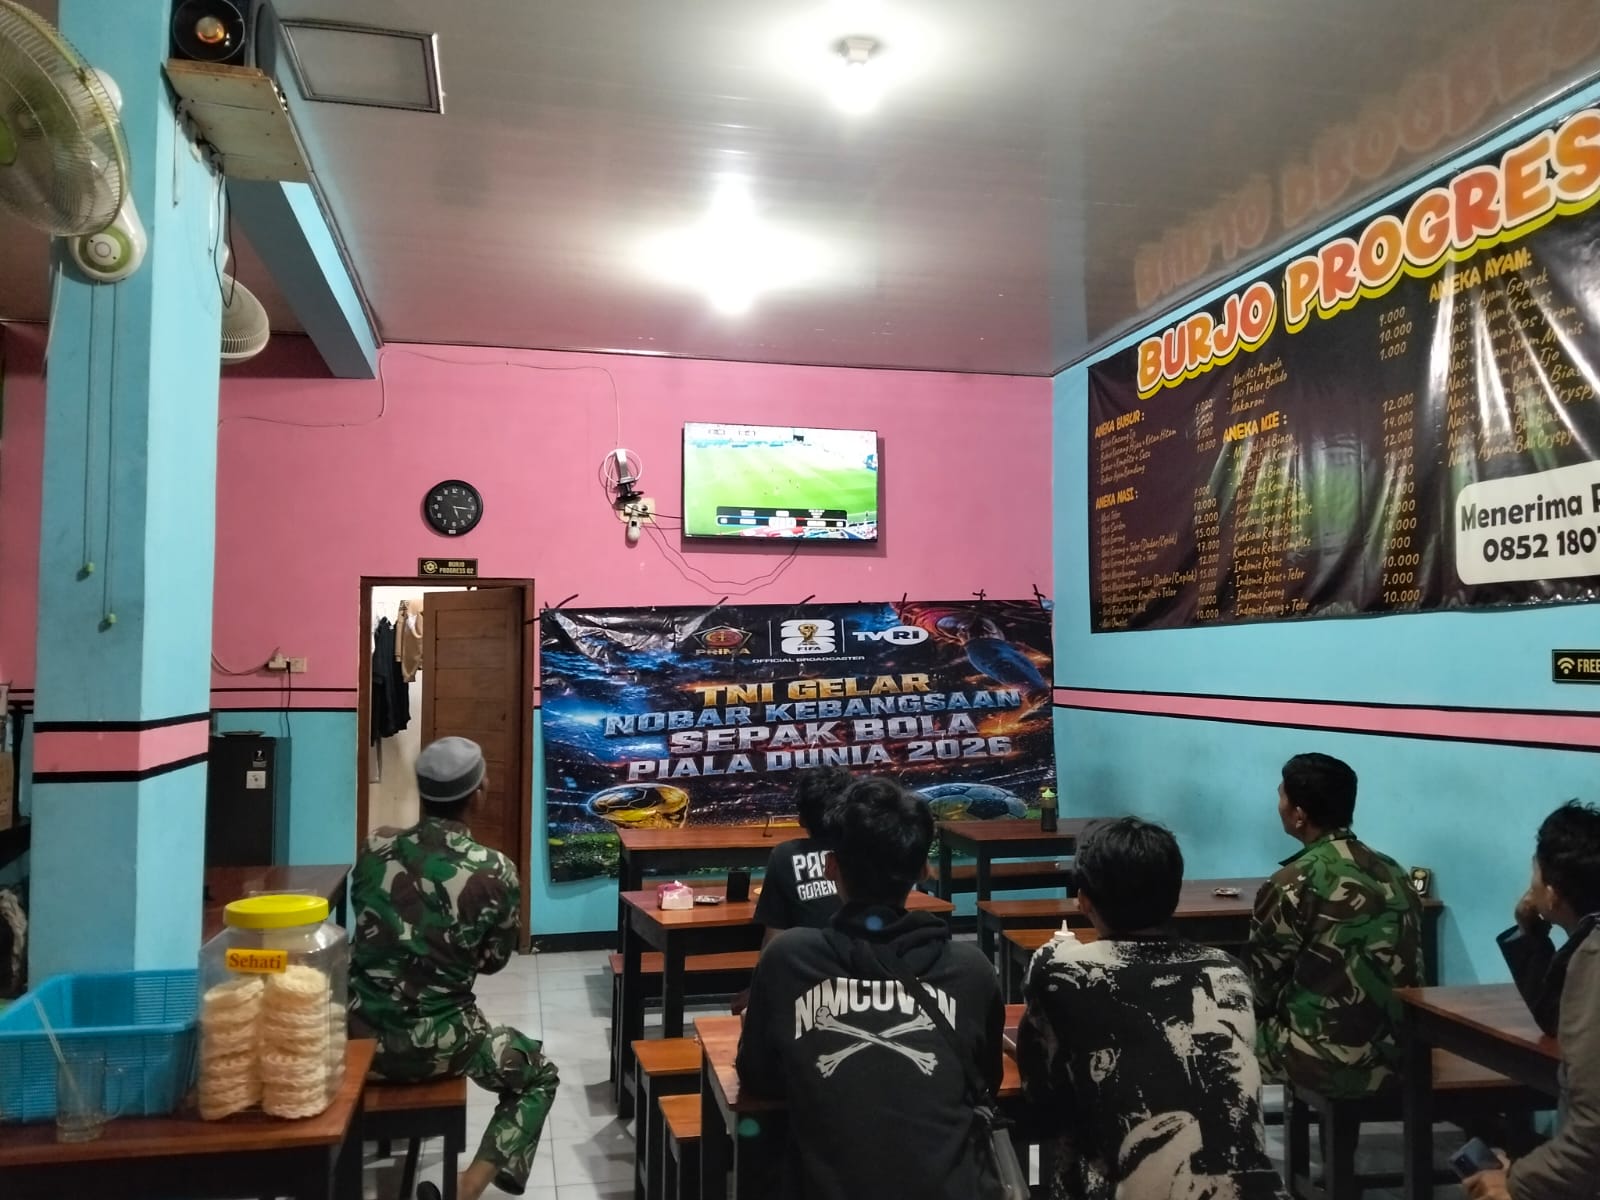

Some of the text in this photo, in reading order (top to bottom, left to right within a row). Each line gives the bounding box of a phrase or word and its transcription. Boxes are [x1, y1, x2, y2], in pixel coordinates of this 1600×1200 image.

[1137, 281, 1276, 397] BURJO
[1285, 108, 1600, 332] PROGRES
[1429, 266, 1481, 303] ANEKA
[1480, 289, 1504, 308] Ayam
[1506, 266, 1548, 295] Geprek
[1541, 305, 1576, 325] Tram
[1509, 336, 1539, 352] Asm
[1541, 320, 1584, 345] Mnis
[1511, 352, 1533, 374] Cab
[1539, 347, 1560, 368] Ijo
[1551, 364, 1583, 383] Bias
[1223, 419, 1259, 443] ANEKA
[1461, 494, 1583, 532] Menerima
[1483, 525, 1600, 563] 0852 180
[1382, 553, 1419, 569] 10.000
[1383, 589, 1420, 603] 10.000
[852, 627, 923, 643] TVRI
[1577, 658, 1600, 673] FREE
[695, 672, 931, 706] TNI GELAR
[603, 688, 1022, 737] NOBAR KEBANGSAAN
[670, 712, 980, 754] SEPAK BOLA
[626, 736, 1014, 782] PIALA DUNIA 2026
[229, 952, 282, 969] Sehati
